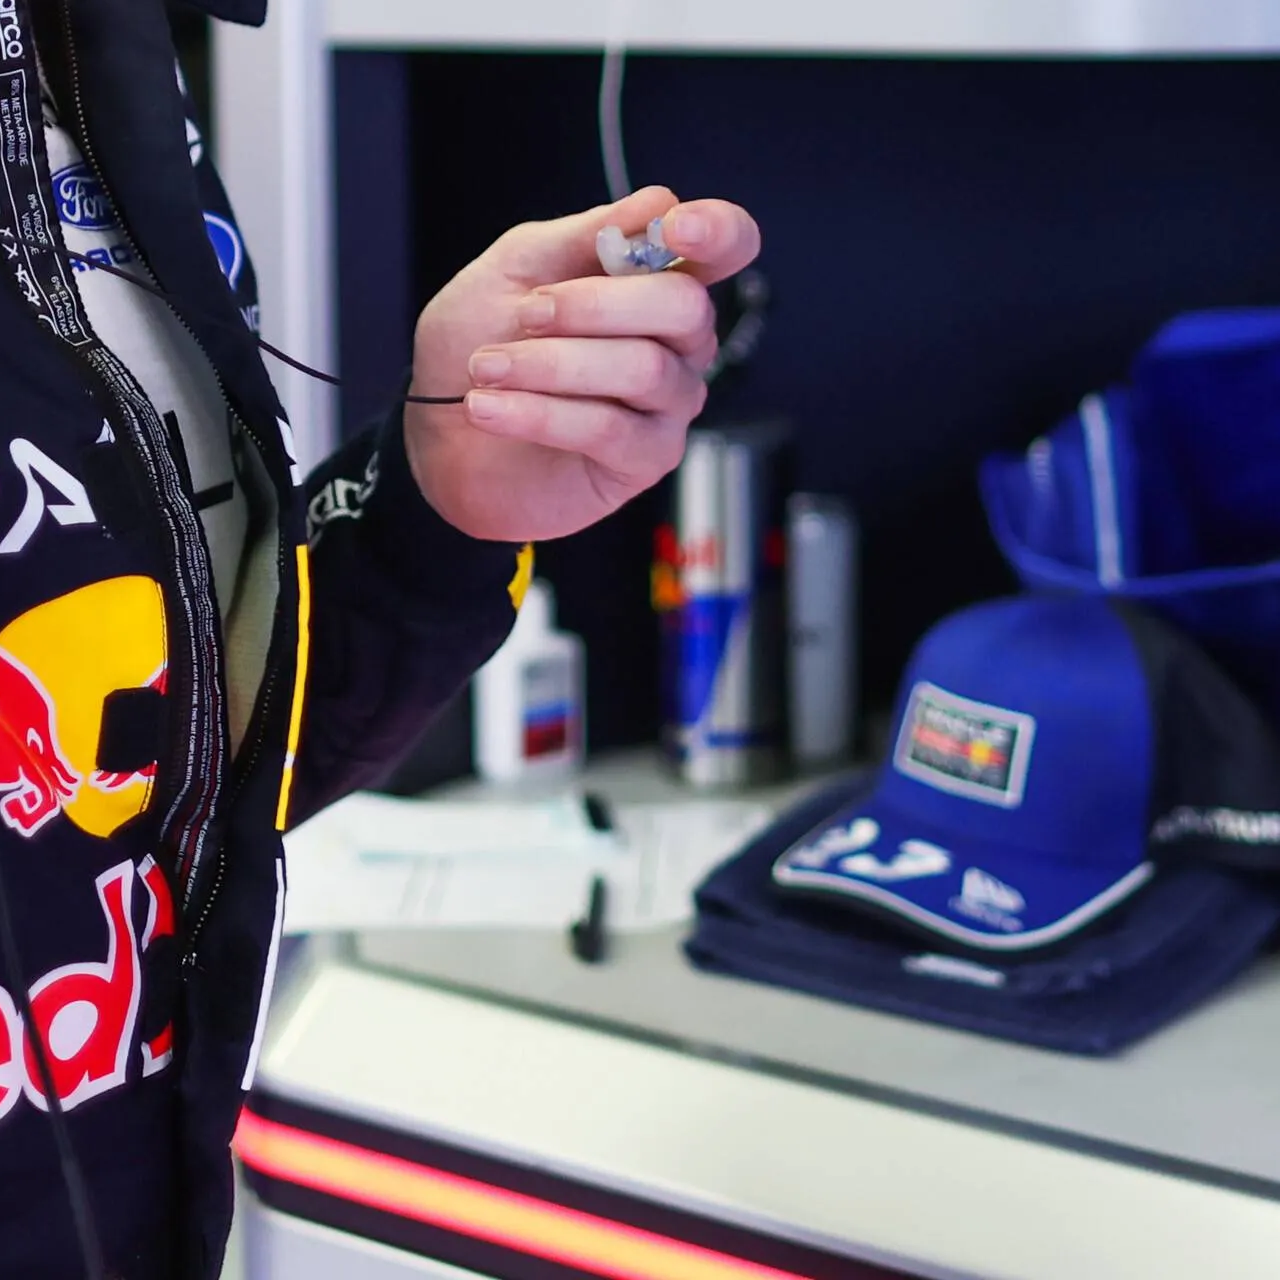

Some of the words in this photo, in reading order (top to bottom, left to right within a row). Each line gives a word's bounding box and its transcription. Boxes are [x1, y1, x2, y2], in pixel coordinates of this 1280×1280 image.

[49, 293, 70, 337] ELASTAN
[50, 275, 62, 290] 6%
[58, 290, 79, 334] ELASTAN
